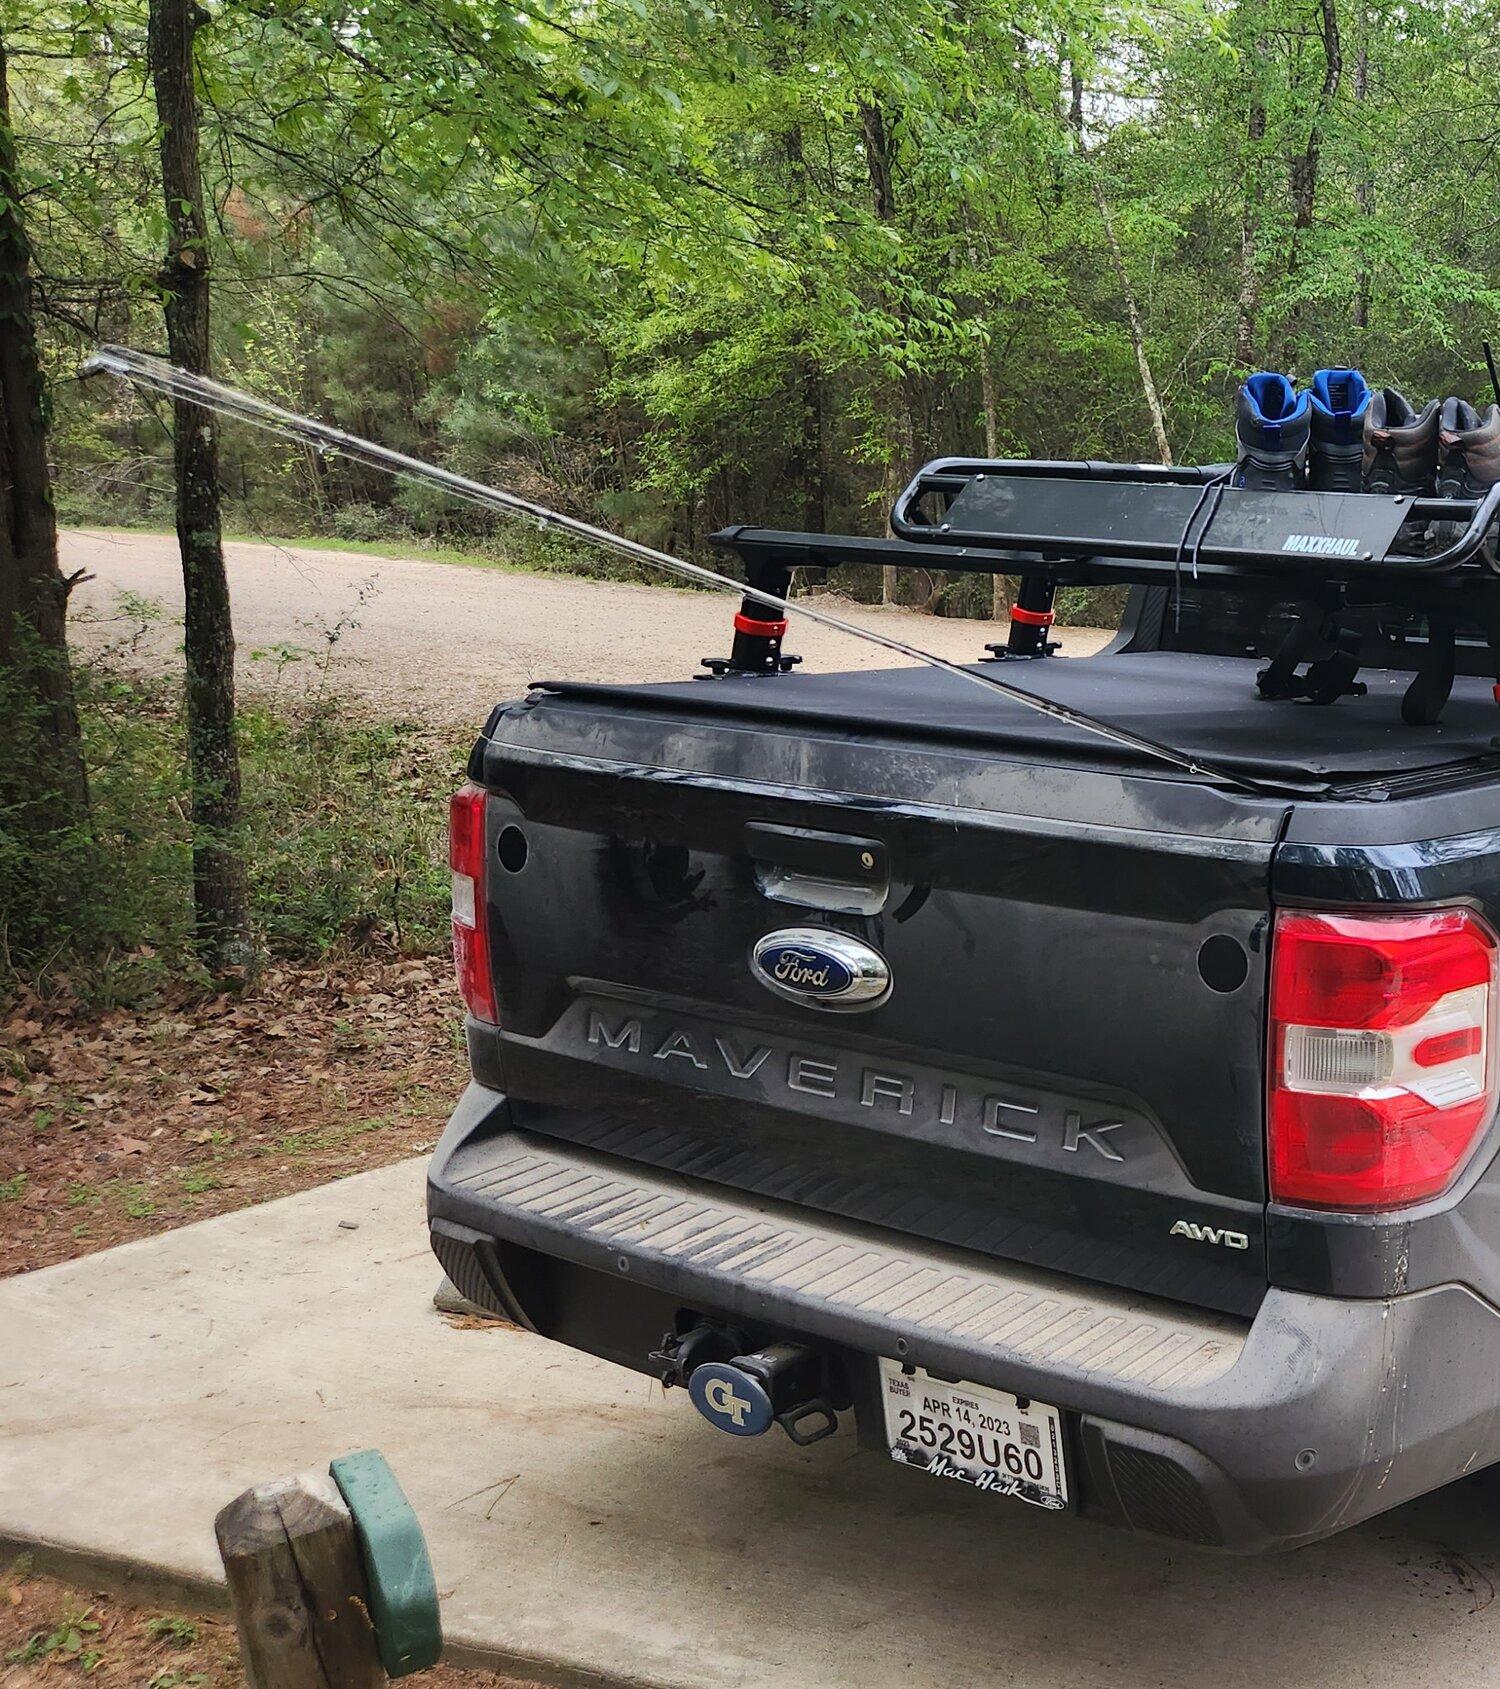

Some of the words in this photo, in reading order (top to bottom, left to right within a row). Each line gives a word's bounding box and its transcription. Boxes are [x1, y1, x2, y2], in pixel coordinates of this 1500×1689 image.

[1281, 535, 1360, 556] MAXXHAUL
[774, 949, 830, 988] Ford
[586, 1010, 1125, 1162] MAVERICK
[1169, 1220, 1249, 1250] AWD
[888, 1377, 909, 1390] TEXAS
[889, 1386, 911, 1397] BUYER
[705, 1378, 751, 1427] GT
[923, 1396, 952, 1418] APR
[955, 1407, 975, 1429] 14,
[978, 1413, 1011, 1436] 2023
[952, 1396, 980, 1411] EXPIRES
[899, 1409, 1043, 1481] 2529U60
[926, 1455, 966, 1479] Mac
